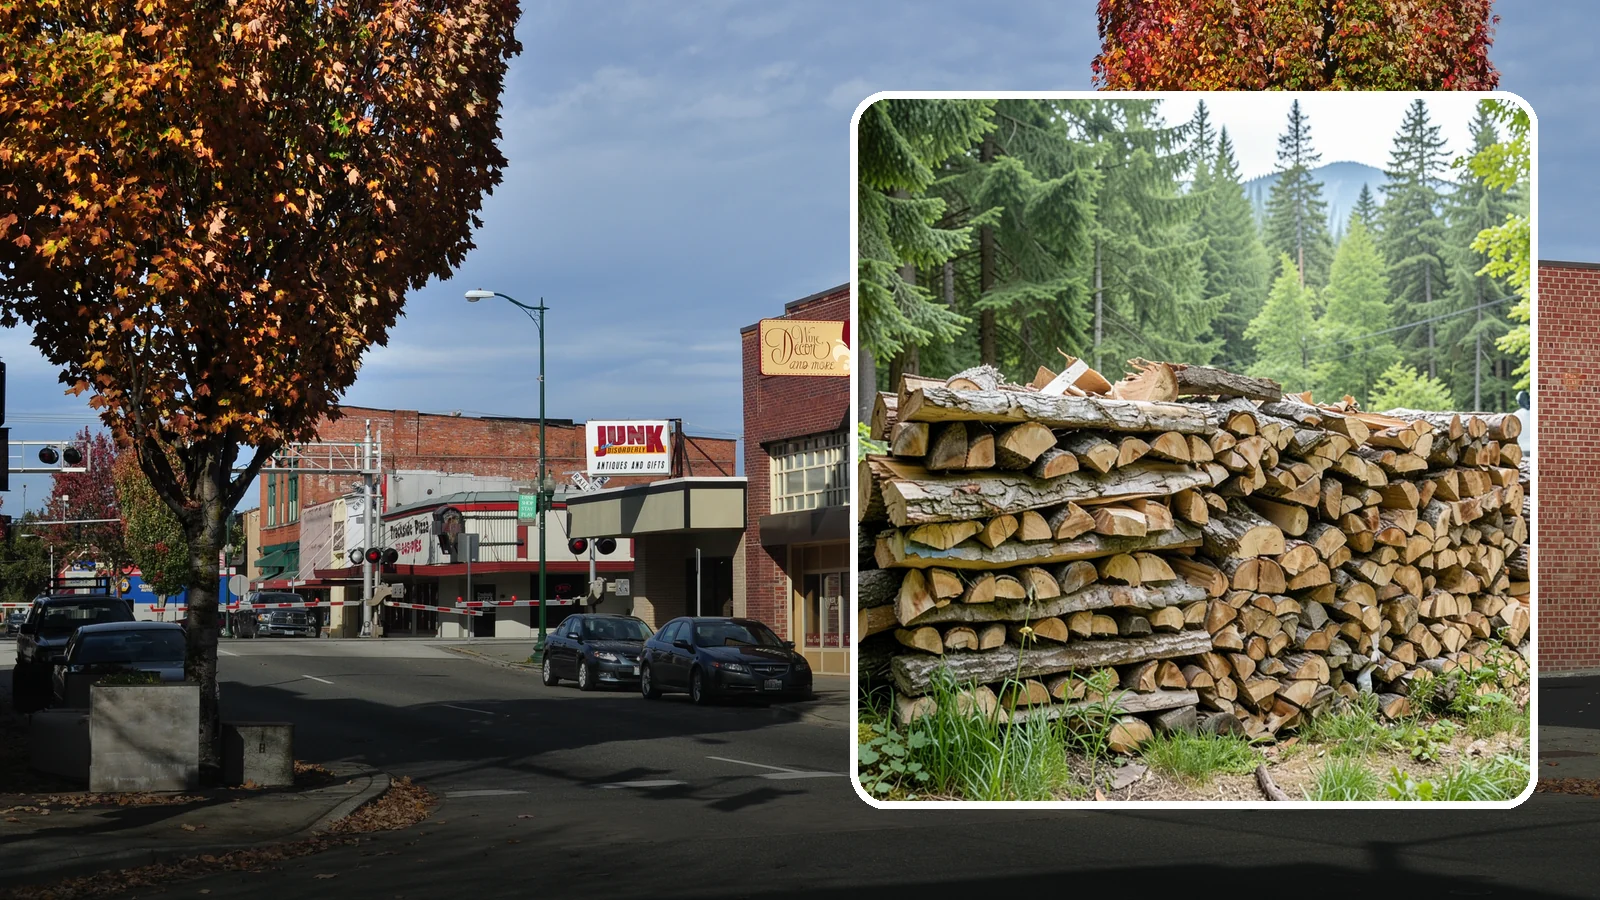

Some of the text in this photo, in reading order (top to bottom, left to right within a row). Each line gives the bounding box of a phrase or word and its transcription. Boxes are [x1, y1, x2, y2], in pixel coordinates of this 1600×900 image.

[595, 425, 665, 457] JUNK
[607, 446, 646, 454] DISORDERLY
[597, 460, 665, 470] ANTIQUES AND GIFTS
[415, 519, 429, 535] Pizza
